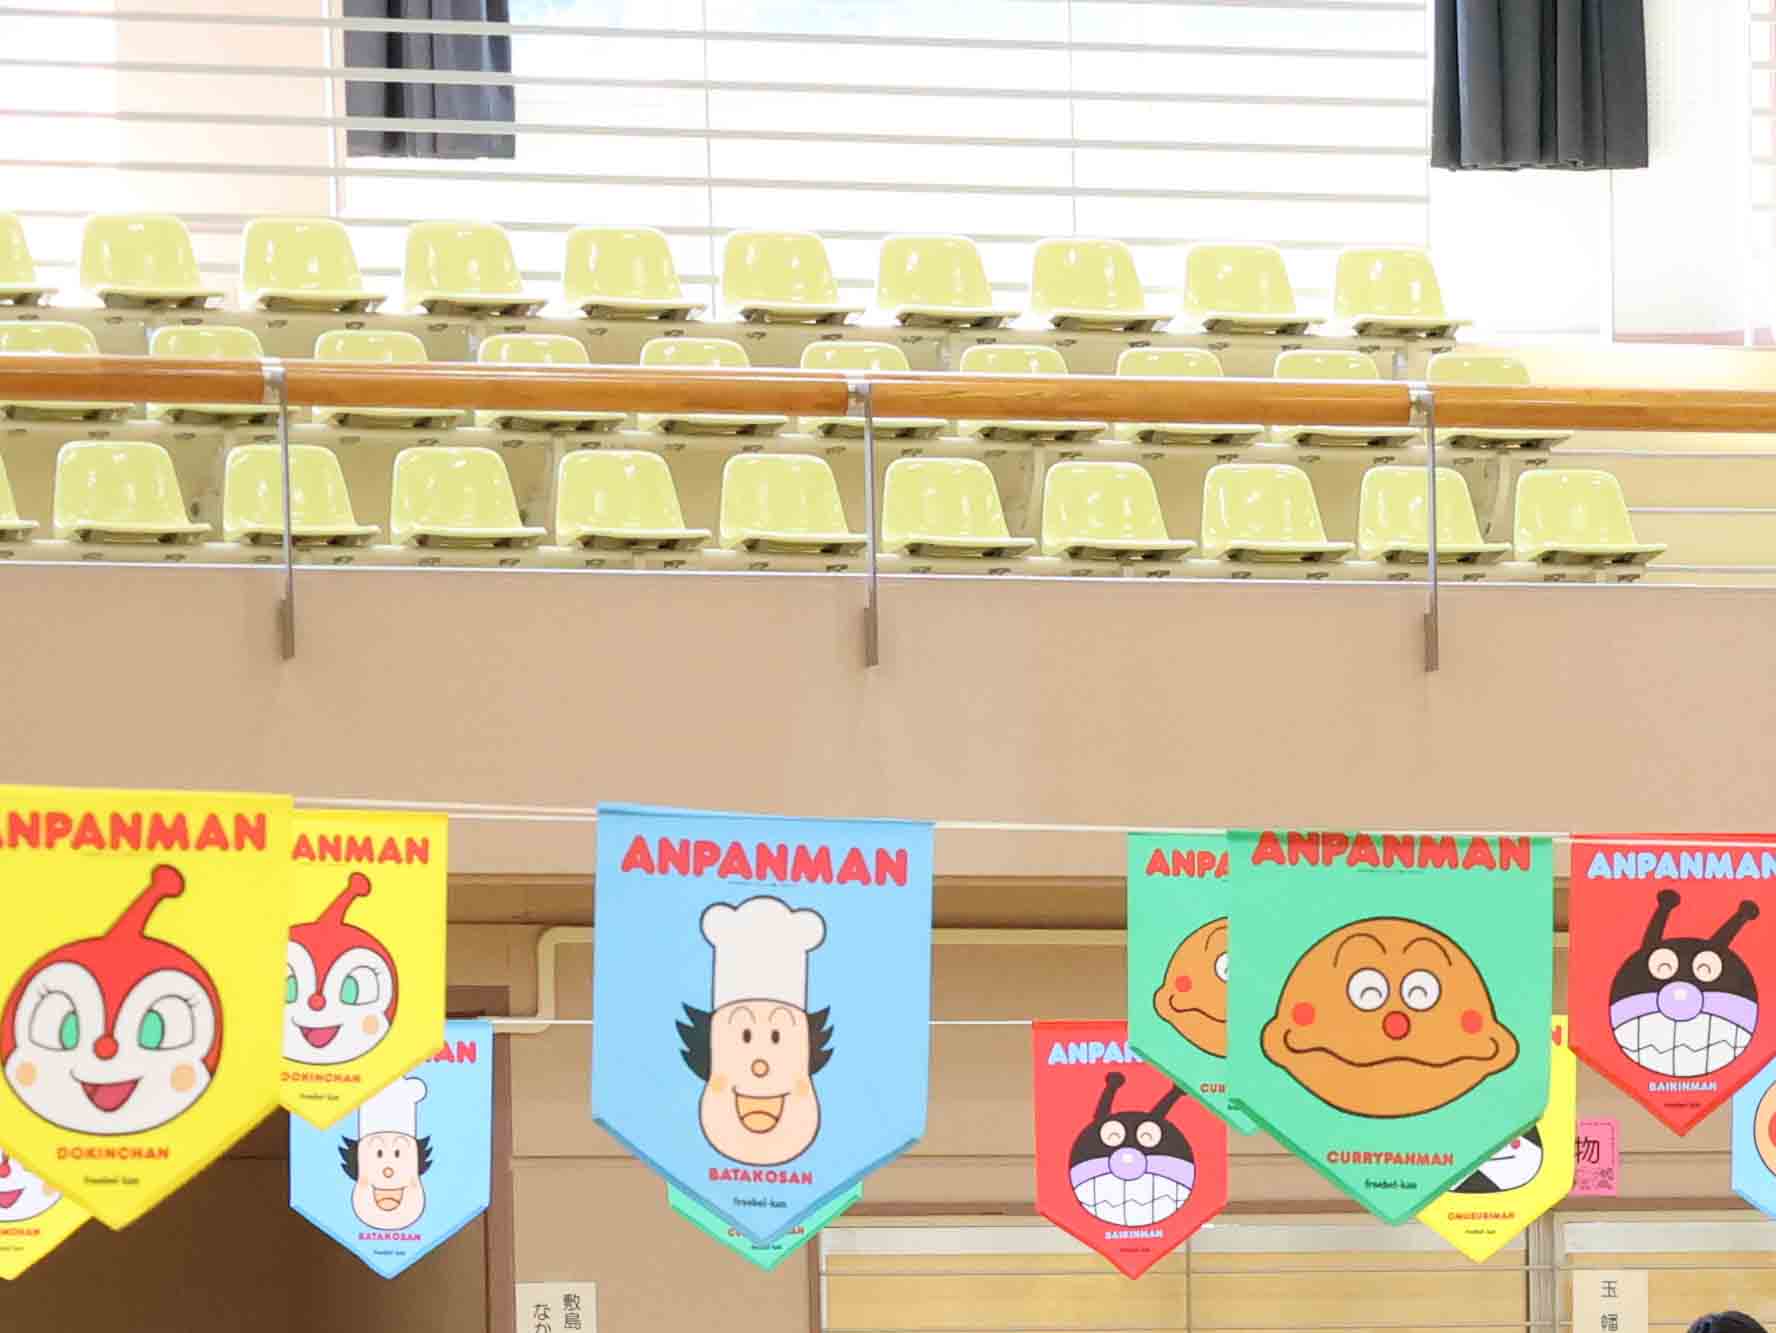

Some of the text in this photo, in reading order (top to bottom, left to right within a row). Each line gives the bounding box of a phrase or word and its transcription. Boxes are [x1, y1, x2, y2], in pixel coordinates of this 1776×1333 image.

[0, 810, 267, 852] NPANMAN
[292, 834, 429, 865] ANMAN
[620, 834, 909, 888] ANPANMAN
[1251, 830, 1531, 872] ANPANMAN
[1648, 1081, 1719, 1093] BAIKINMAN
[1326, 1150, 1454, 1167] CURRYPANMAN
[1575, 1136, 1600, 1165] 物
[708, 1167, 814, 1185] BATAKOSAN
[562, 1291, 582, 1331] 敷島
